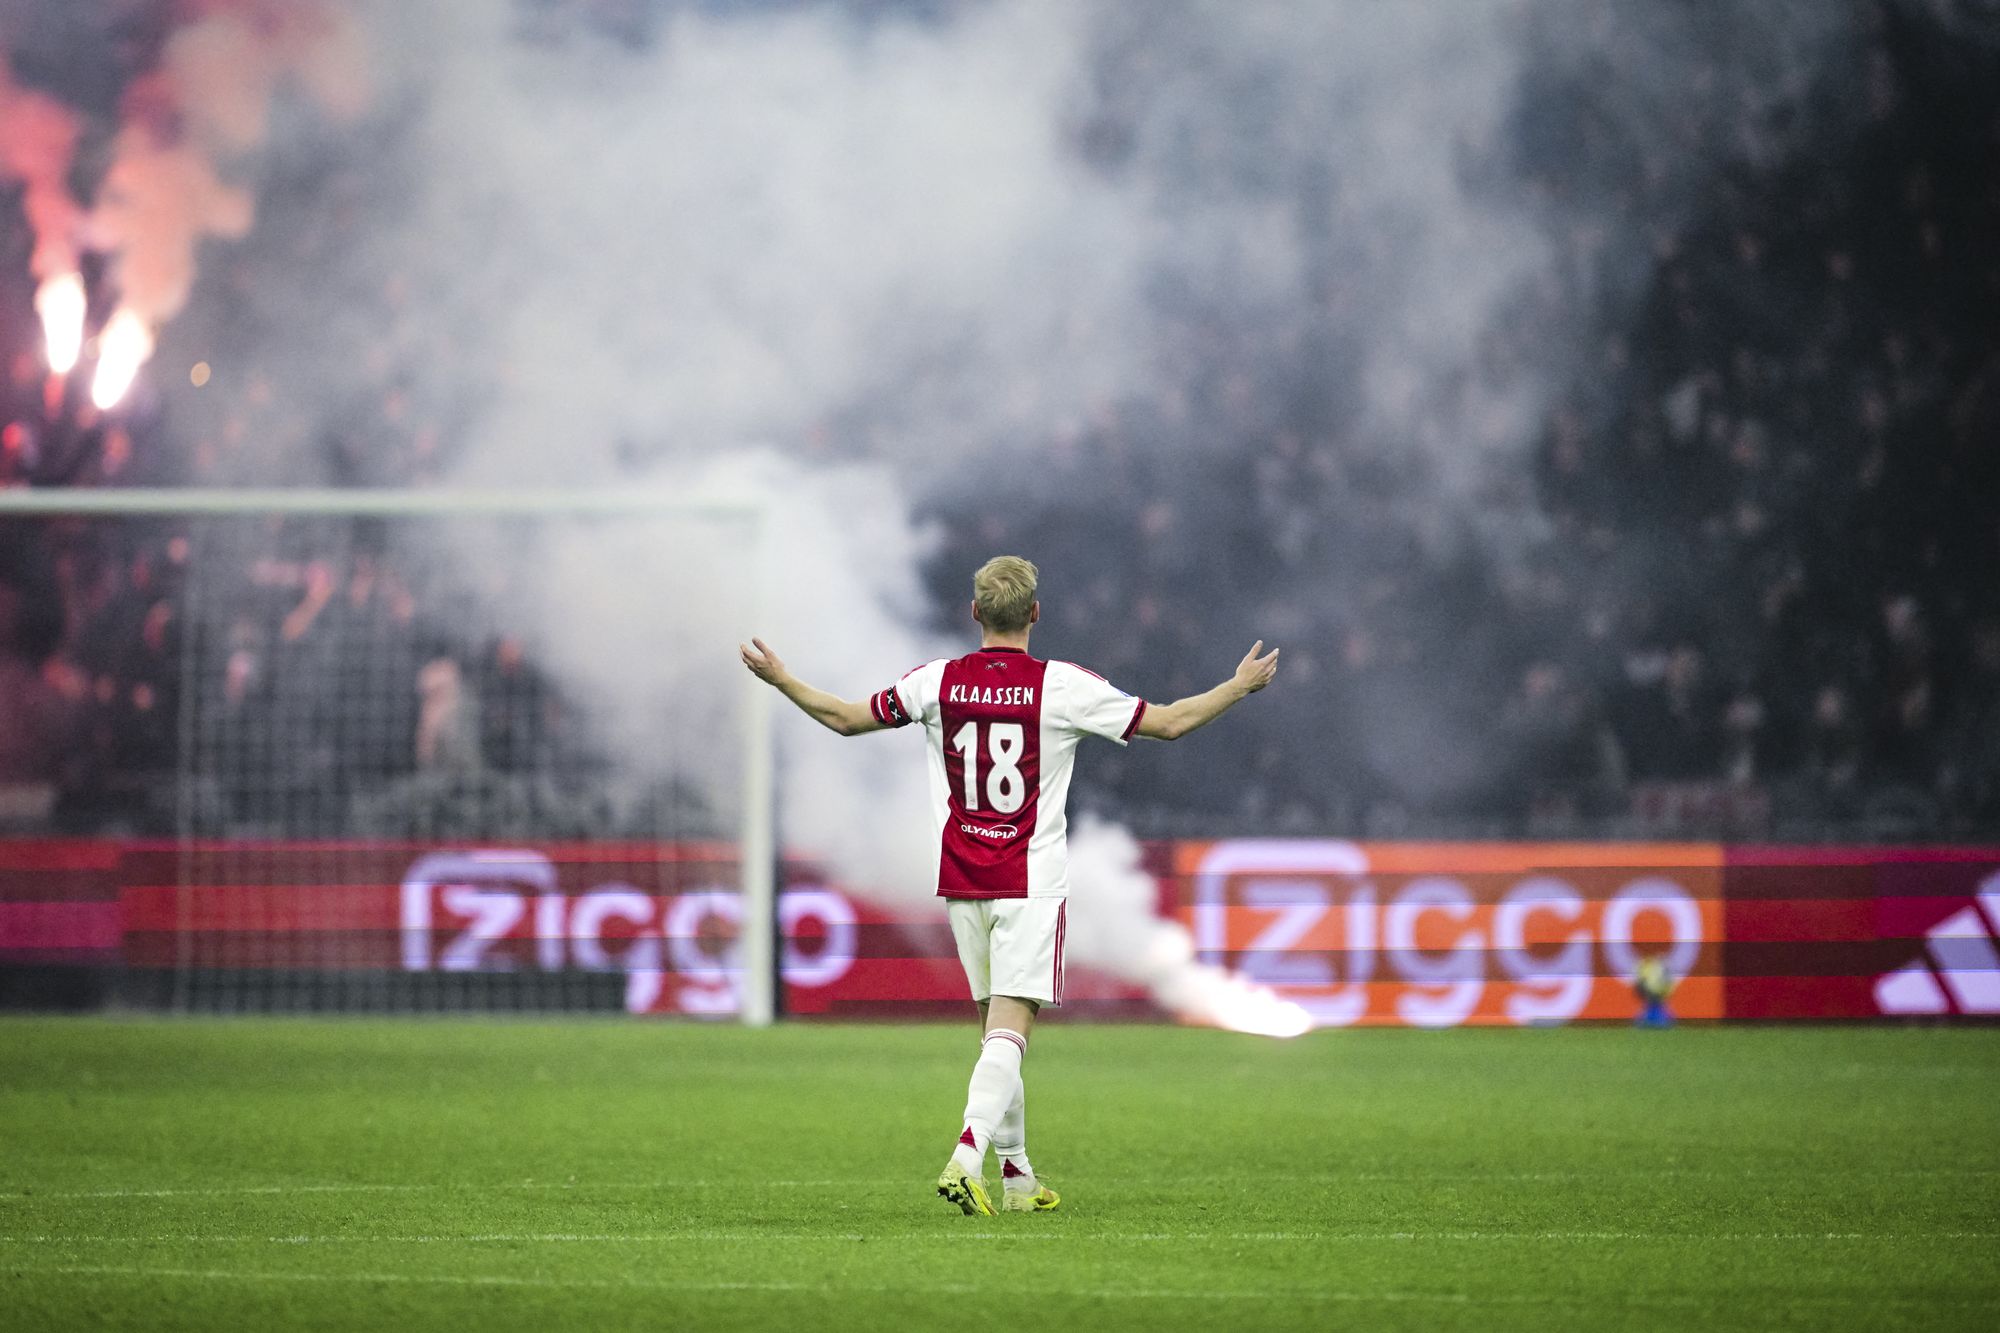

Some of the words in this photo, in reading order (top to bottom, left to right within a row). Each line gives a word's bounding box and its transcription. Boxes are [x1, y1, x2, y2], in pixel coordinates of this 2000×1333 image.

[949, 684, 1034, 705] KLAASSEN
[952, 721, 1026, 814] 18
[961, 824, 1017, 839] OLYMPIA
